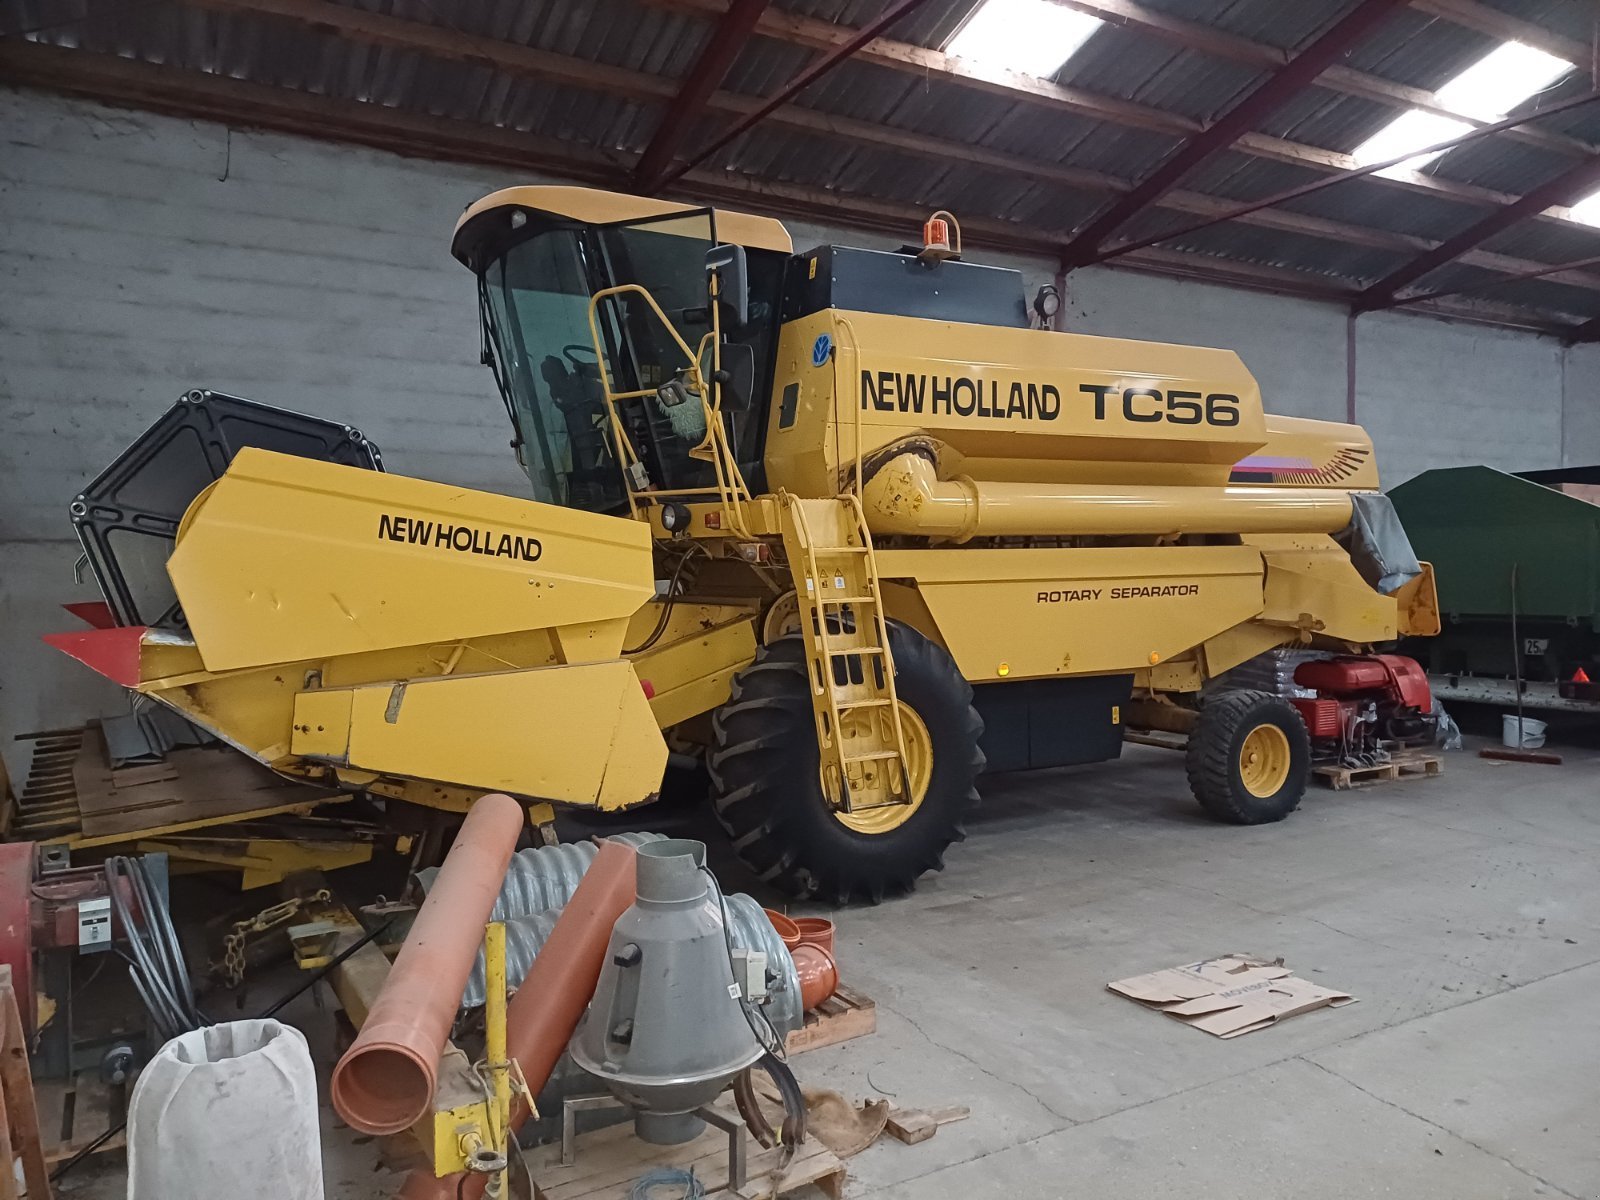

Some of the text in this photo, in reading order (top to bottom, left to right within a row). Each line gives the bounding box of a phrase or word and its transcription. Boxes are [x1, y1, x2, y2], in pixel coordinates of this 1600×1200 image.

[861, 370, 1240, 426] NEW HOLLAND TC56
[378, 514, 542, 562] NEW HOLLAND
[1037, 585, 1199, 603] ROTARY SEPARATOR
